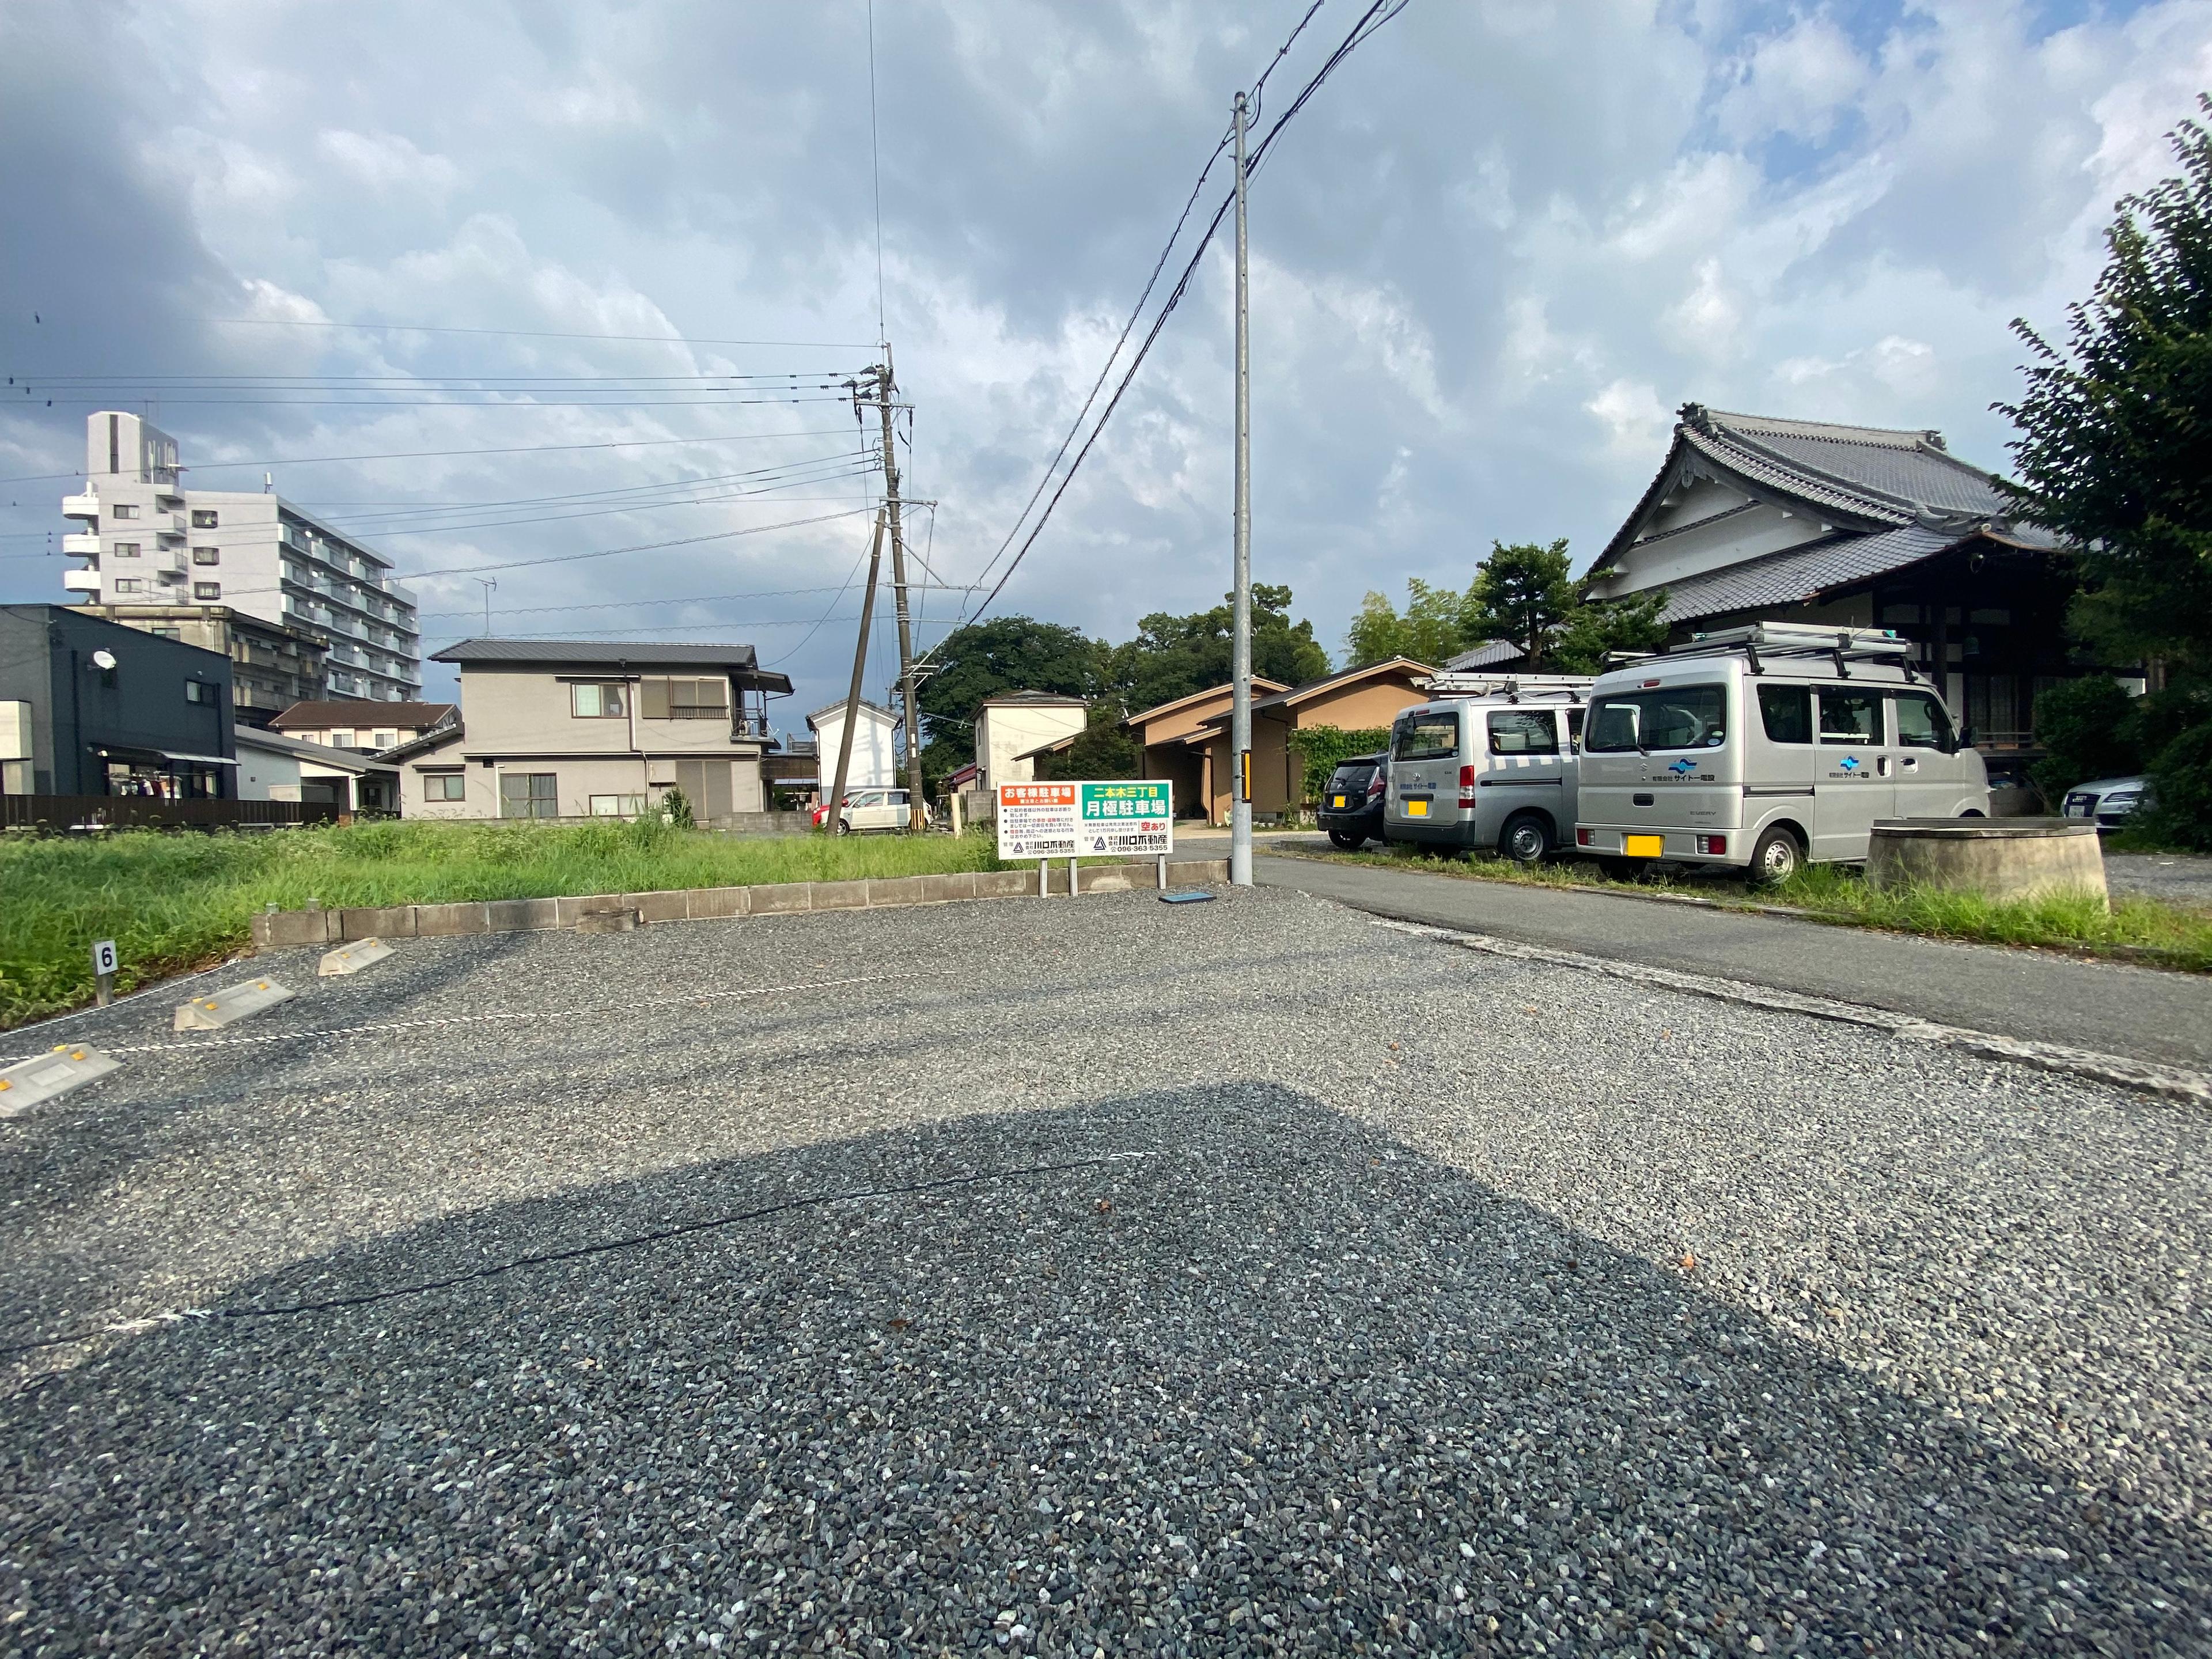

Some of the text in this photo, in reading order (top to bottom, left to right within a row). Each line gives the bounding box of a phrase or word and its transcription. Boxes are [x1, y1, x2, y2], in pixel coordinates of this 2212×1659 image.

[1005, 787, 1071, 798] お客様駐車場
[1094, 786, 1158, 798] 二本木三丁目
[1086, 800, 1166, 817] 月極駐車場
[1141, 821, 1165, 831] 空あり
[1119, 834, 1167, 846] 川口不動産
[102, 947, 112, 967] 6
